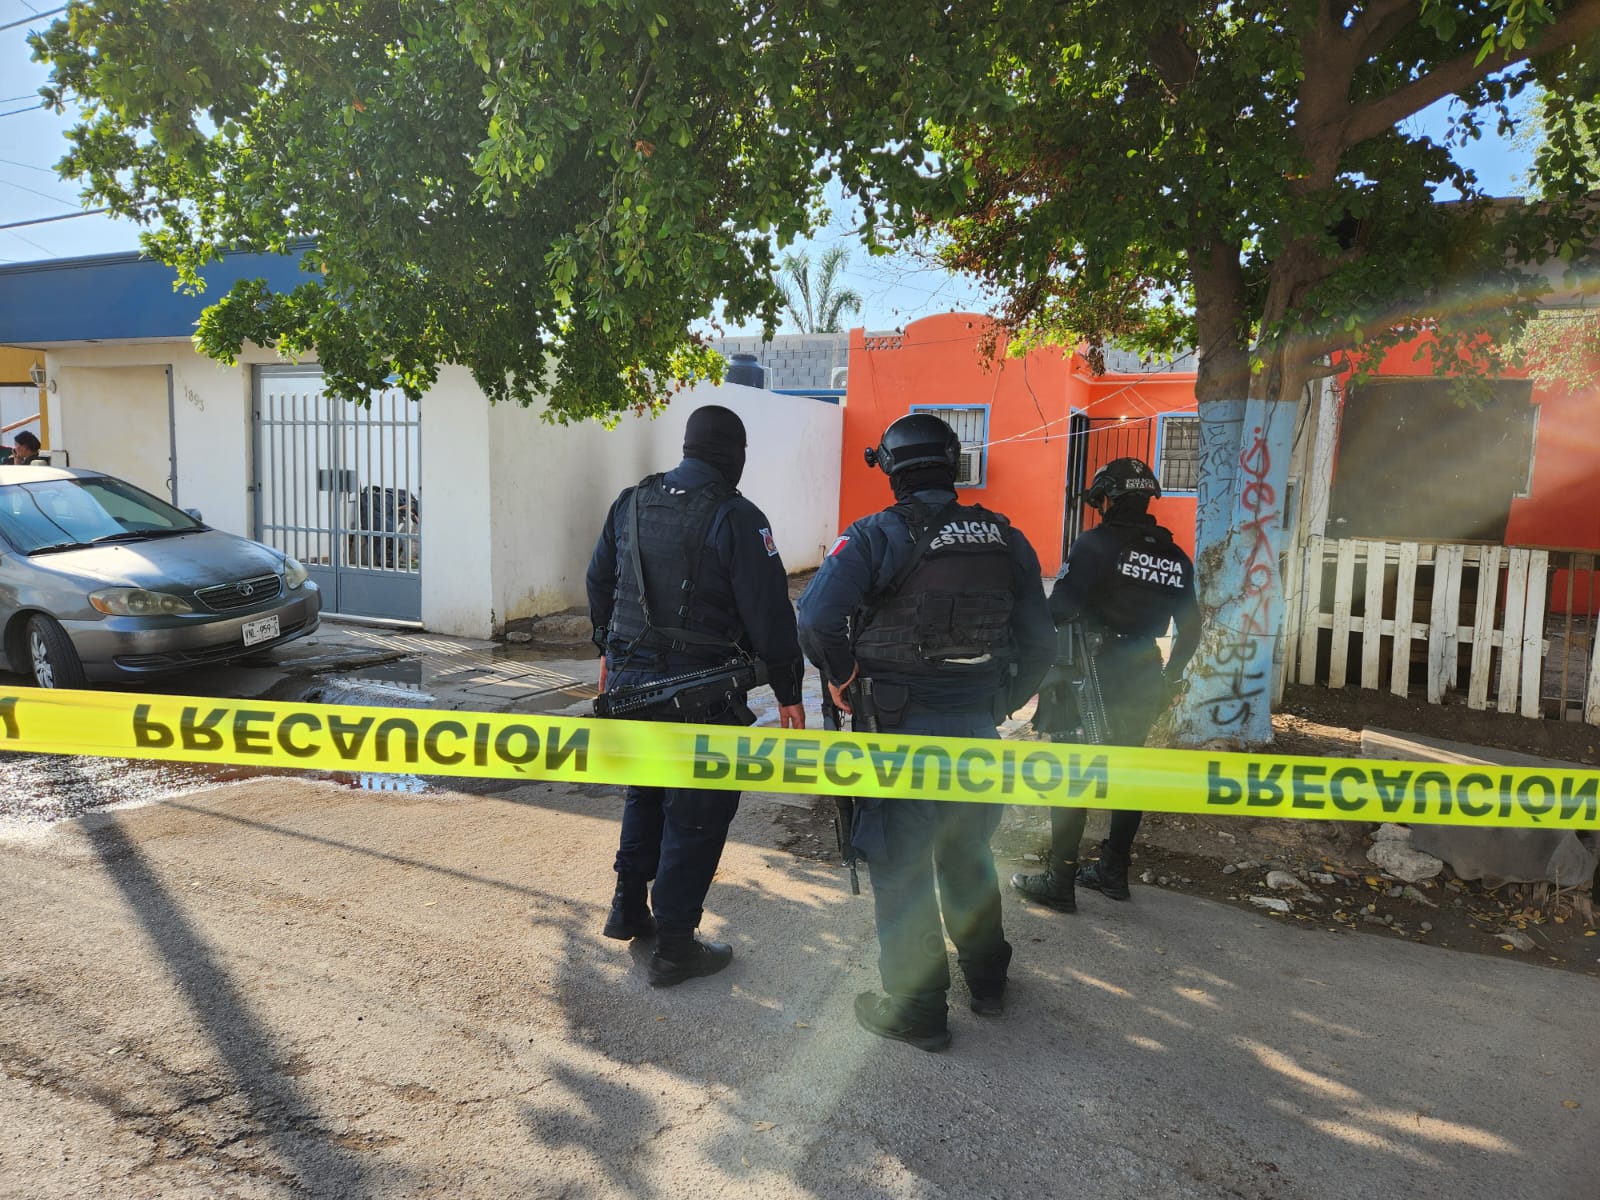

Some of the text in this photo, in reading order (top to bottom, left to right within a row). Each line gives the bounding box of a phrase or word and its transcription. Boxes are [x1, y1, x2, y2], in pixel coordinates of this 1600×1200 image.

[184, 384, 205, 412] 1893
[1128, 550, 1183, 574] POLICIA
[1121, 563, 1185, 588] ESTATAL
